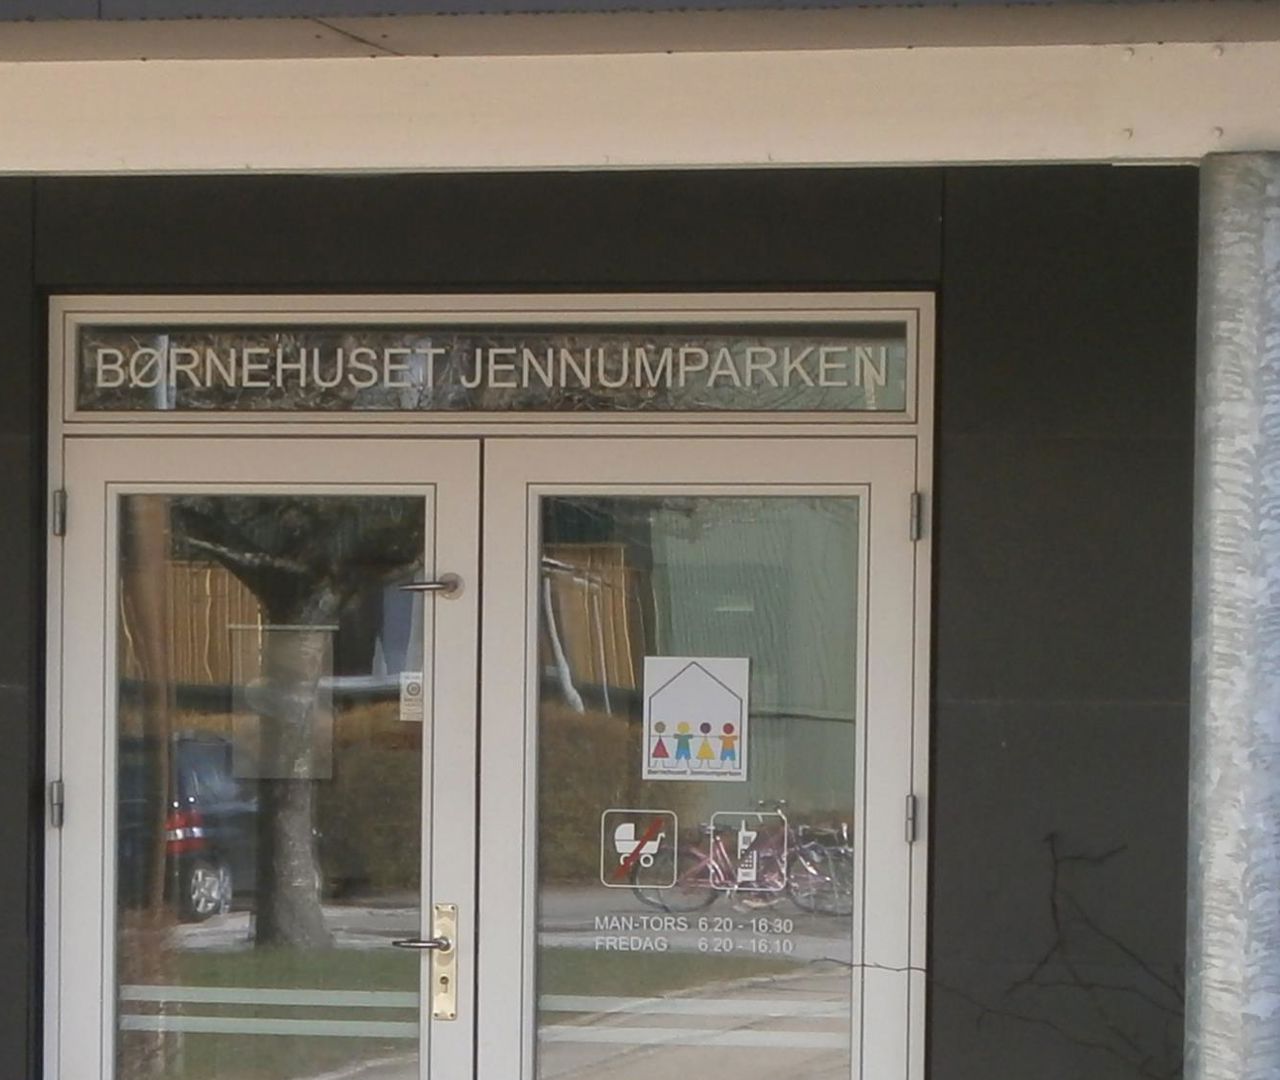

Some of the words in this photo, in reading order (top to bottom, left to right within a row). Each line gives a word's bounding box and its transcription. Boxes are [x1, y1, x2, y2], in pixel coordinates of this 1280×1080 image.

[95, 347, 446, 388] BØRNEHUSET
[460, 348, 888, 388] JENNUMPARKEN
[594, 916, 689, 932] MAN-TORS
[698, 917, 733, 932] 6.20
[594, 936, 668, 952] FREDAG
[698, 937, 733, 953] 6.20
